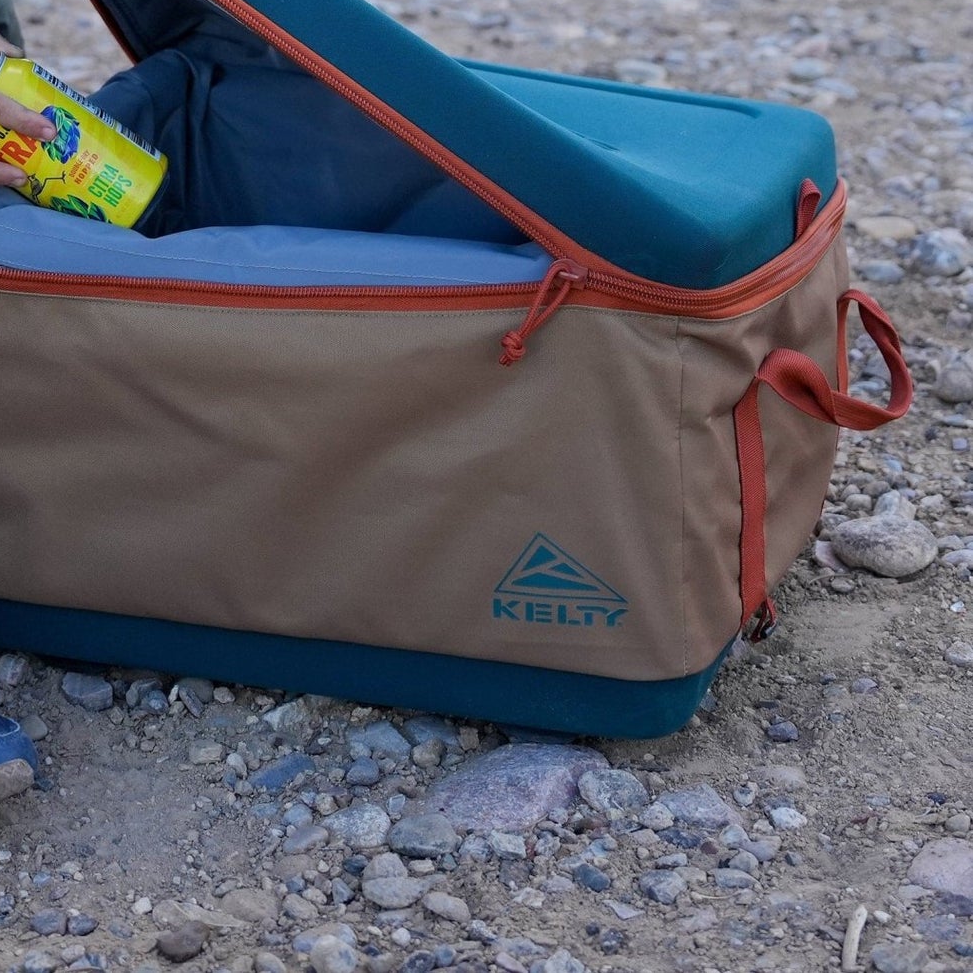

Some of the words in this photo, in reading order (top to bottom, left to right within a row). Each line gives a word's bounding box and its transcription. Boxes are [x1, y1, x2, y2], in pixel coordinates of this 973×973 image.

[74, 153, 99, 185] HOPPED
[87, 163, 119, 198] CITRA
[103, 174, 132, 208] HOPS
[492, 597, 629, 628] KELTY
